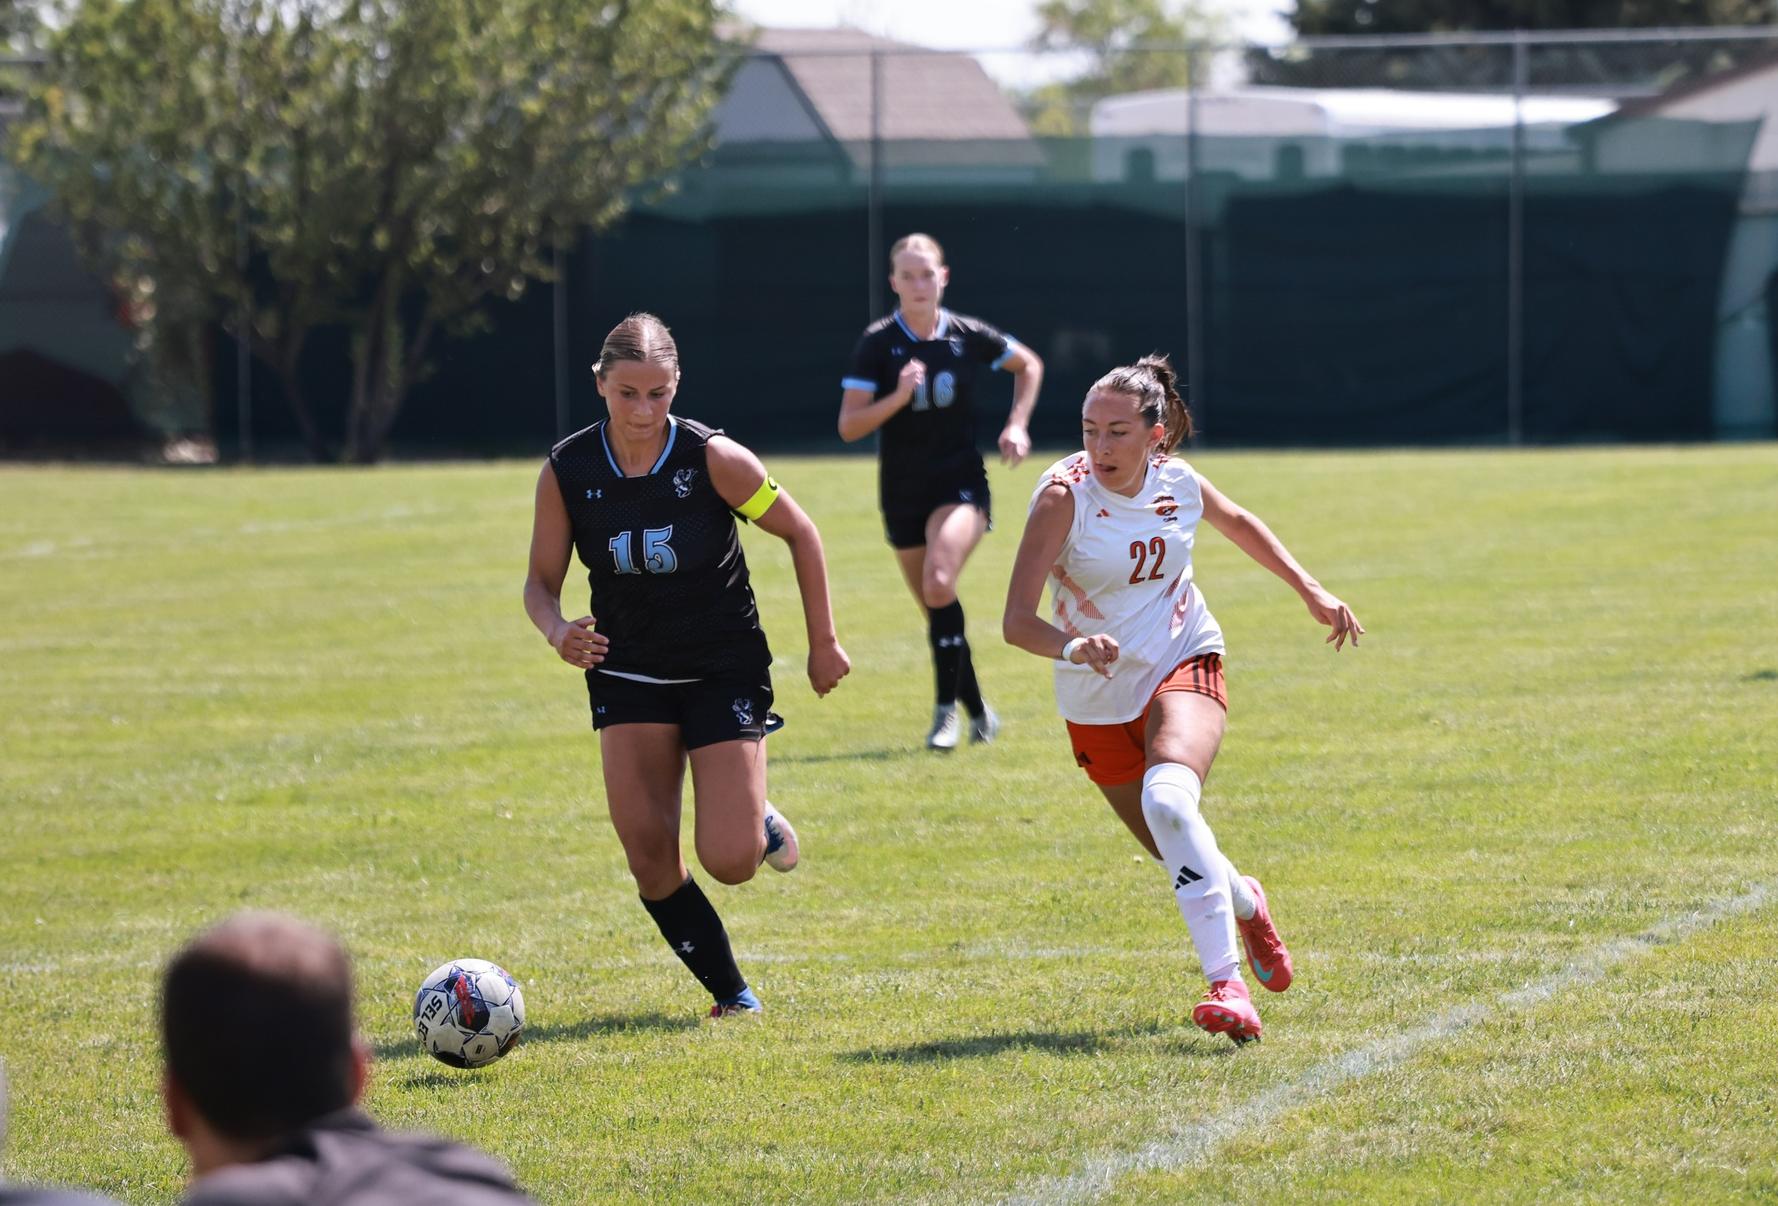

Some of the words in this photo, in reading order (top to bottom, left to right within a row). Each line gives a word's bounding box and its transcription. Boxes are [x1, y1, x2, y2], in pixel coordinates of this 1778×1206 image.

[912, 371, 954, 411] 16
[608, 524, 678, 575] 15
[1129, 536, 1166, 584] 22
